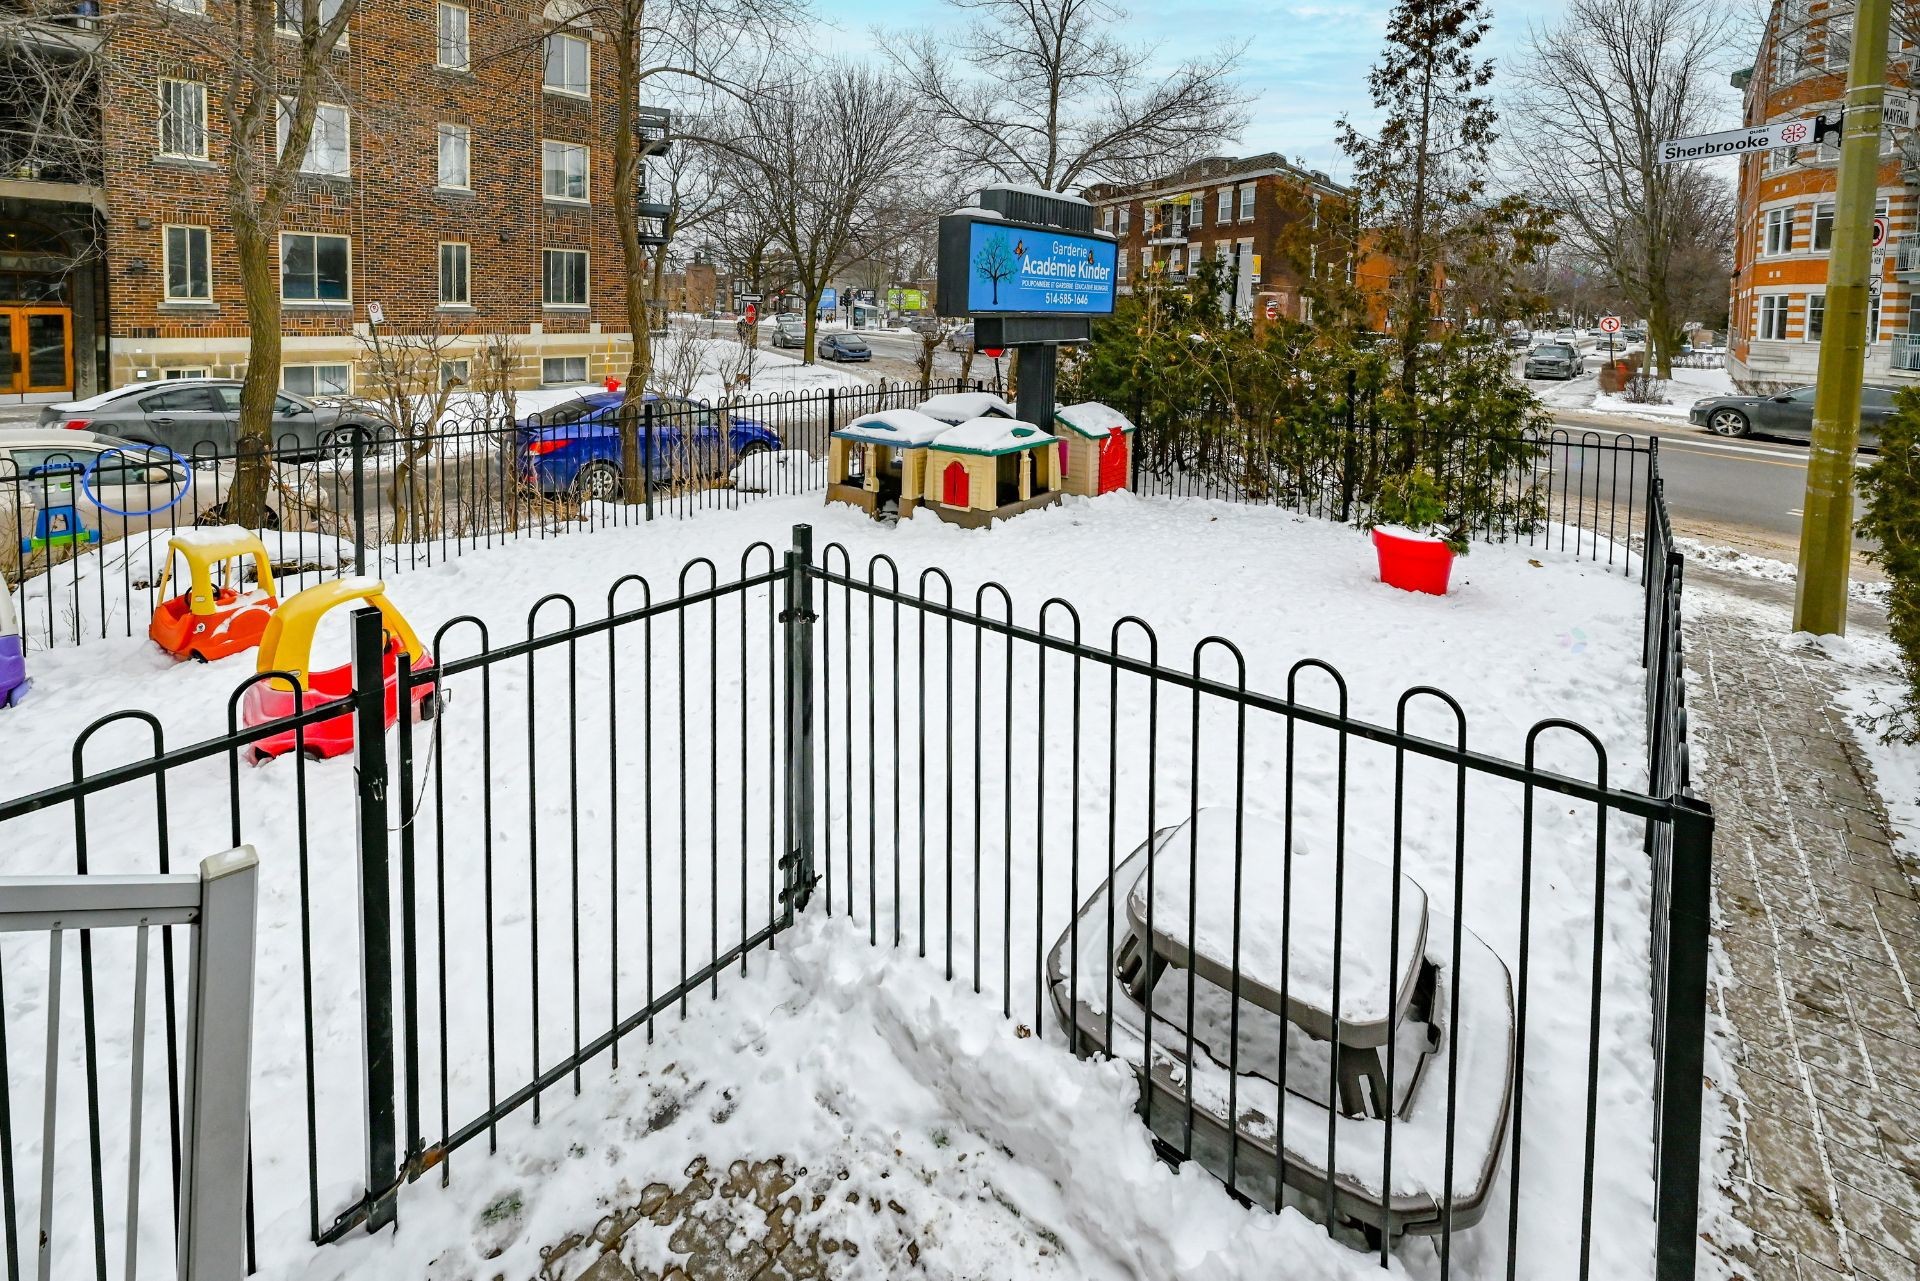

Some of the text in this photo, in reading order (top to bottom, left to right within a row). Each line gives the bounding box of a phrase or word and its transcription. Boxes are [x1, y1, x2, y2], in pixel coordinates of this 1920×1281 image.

[1889, 98, 1907, 109] AVENUE
[1883, 107, 1910, 125] MAYFAIR
[1664, 136, 1769, 160] Sherbrooke
[1052, 240, 1088, 258] Garderie
[1021, 254, 1111, 280] Académie Kinder
[1045, 292, 1089, 305] 514-585-1646
